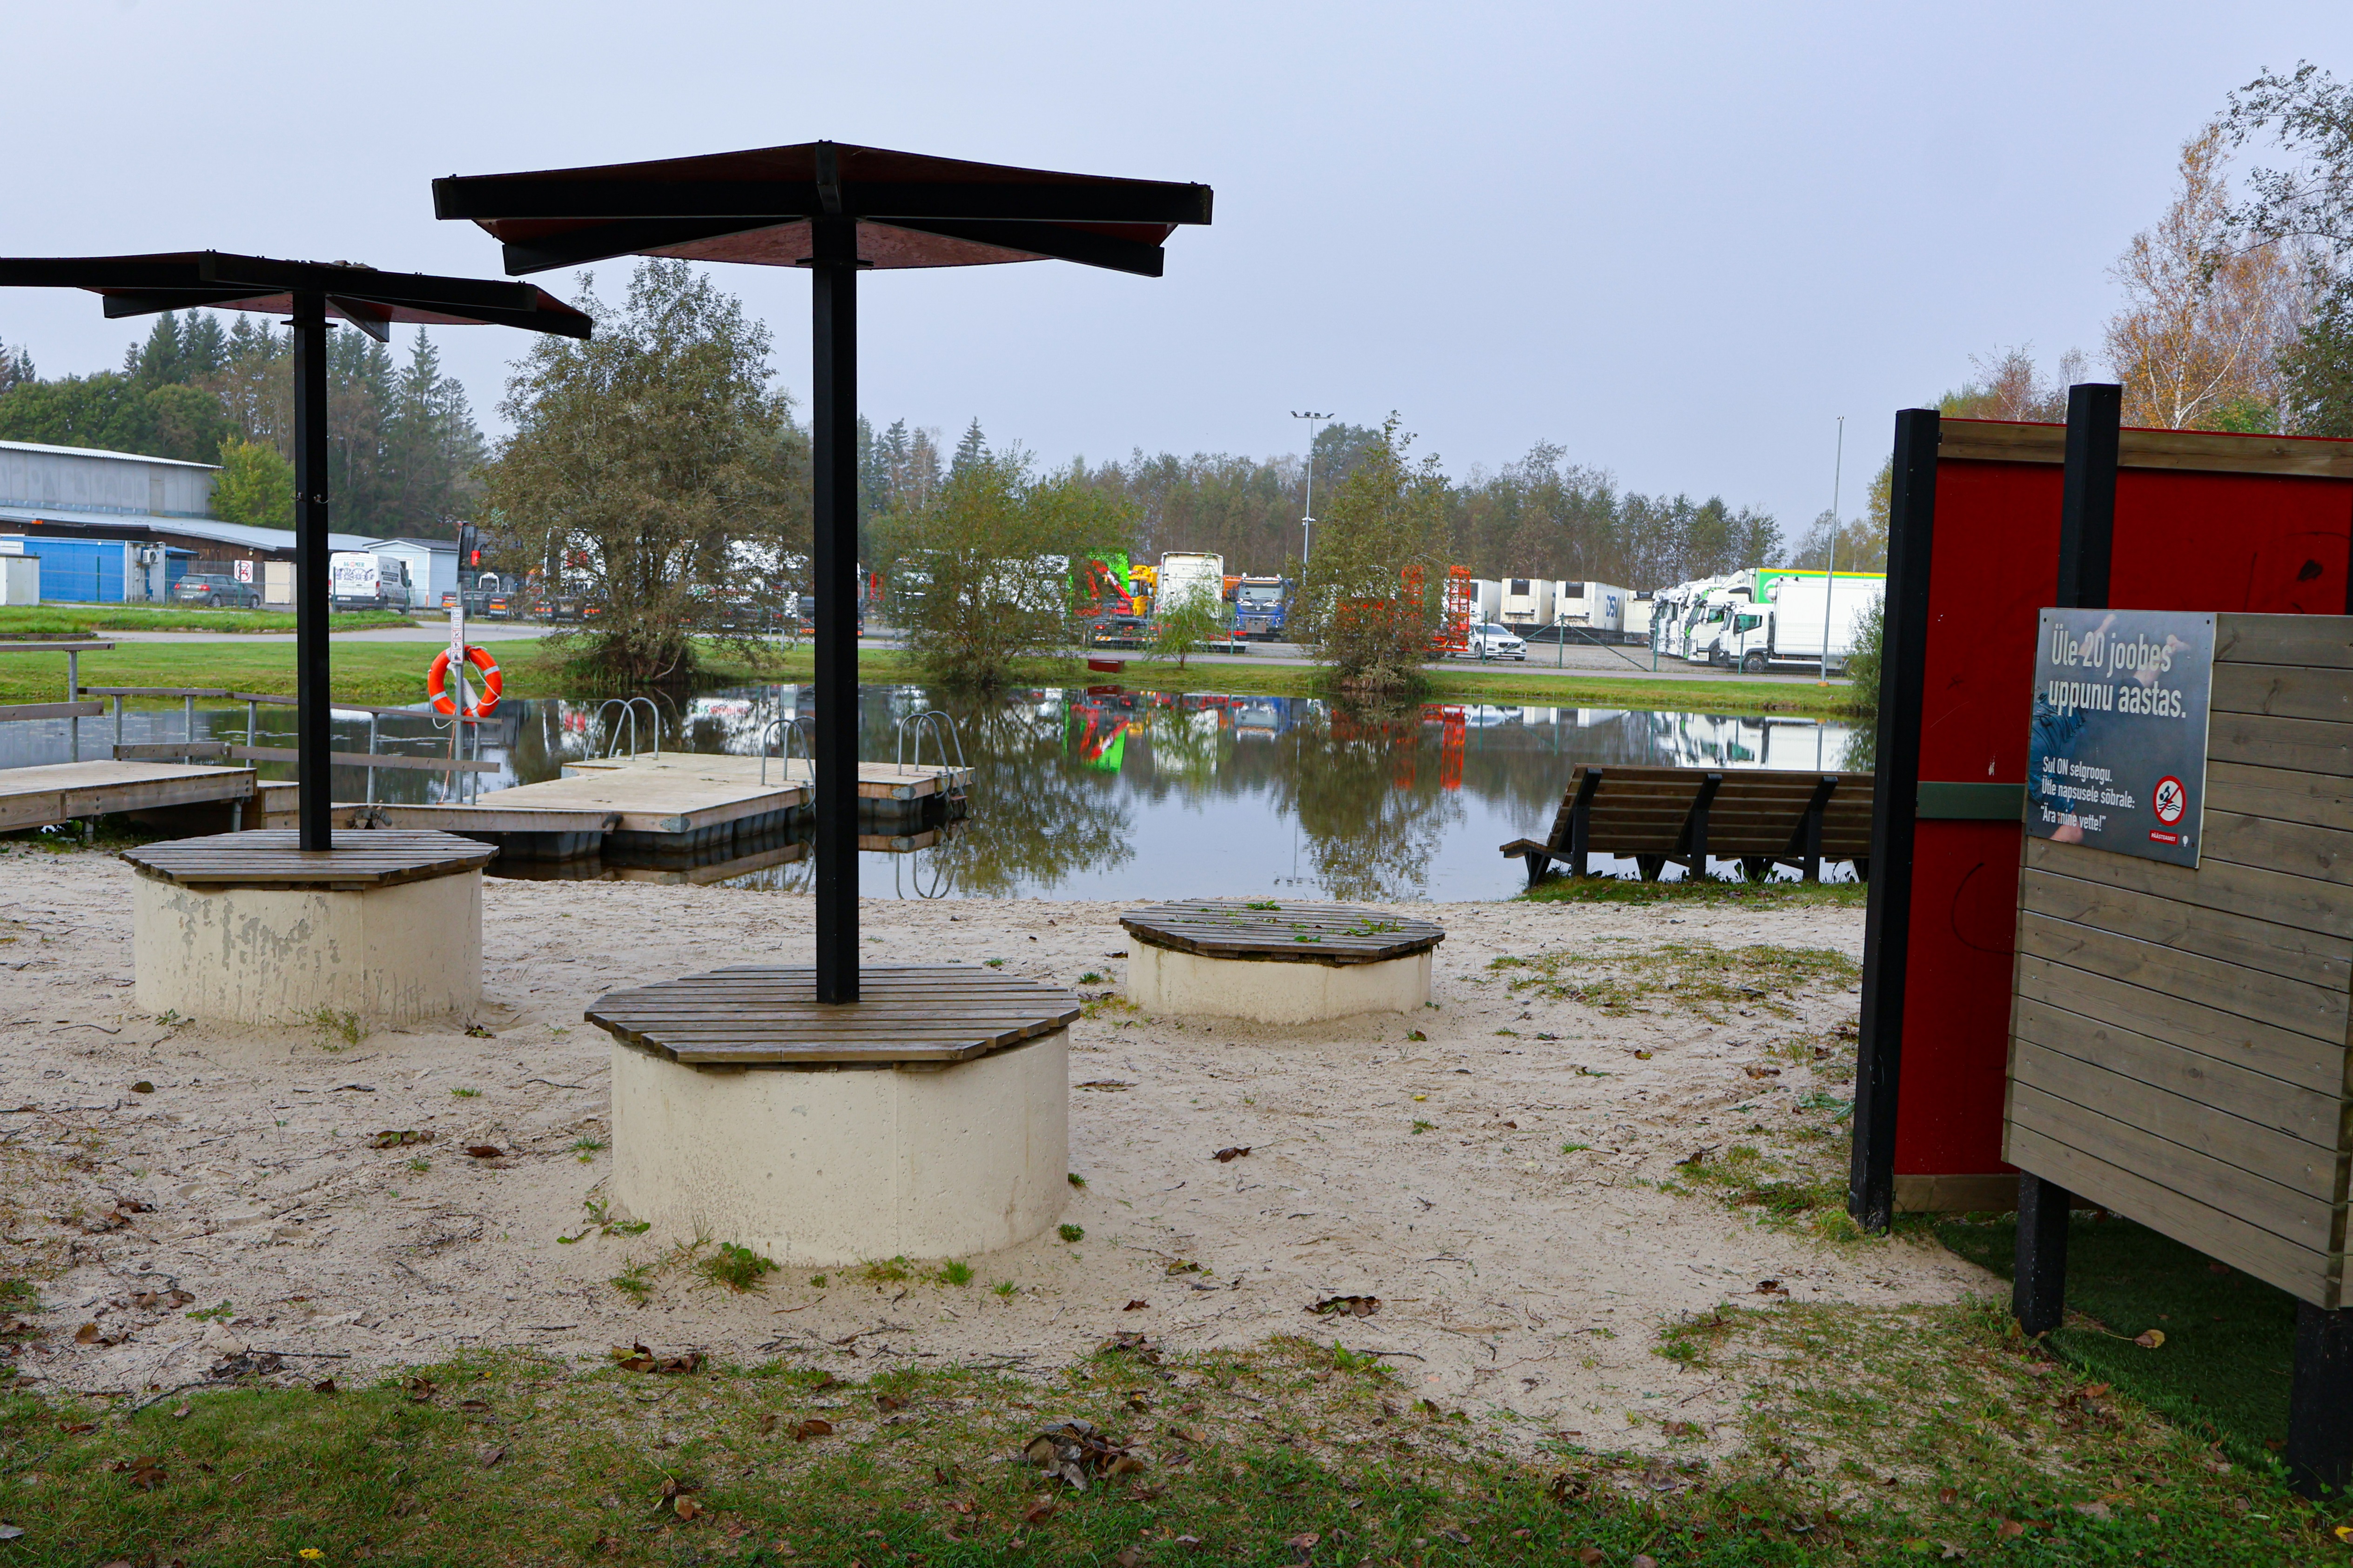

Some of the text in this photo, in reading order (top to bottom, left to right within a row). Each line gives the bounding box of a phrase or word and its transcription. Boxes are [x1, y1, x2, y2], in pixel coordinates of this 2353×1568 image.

[1606, 595, 1620, 618] DSV
[2051, 623, 2172, 678] Üle 20 joobes
[2048, 680, 2186, 718] uppunu aastas.
[2043, 756, 2113, 785] Sul ON selgroogu.
[2042, 775, 2135, 809] Ütle napsusele sõbrale:
[2151, 832, 2176, 842] PÄÄSTEAMET
